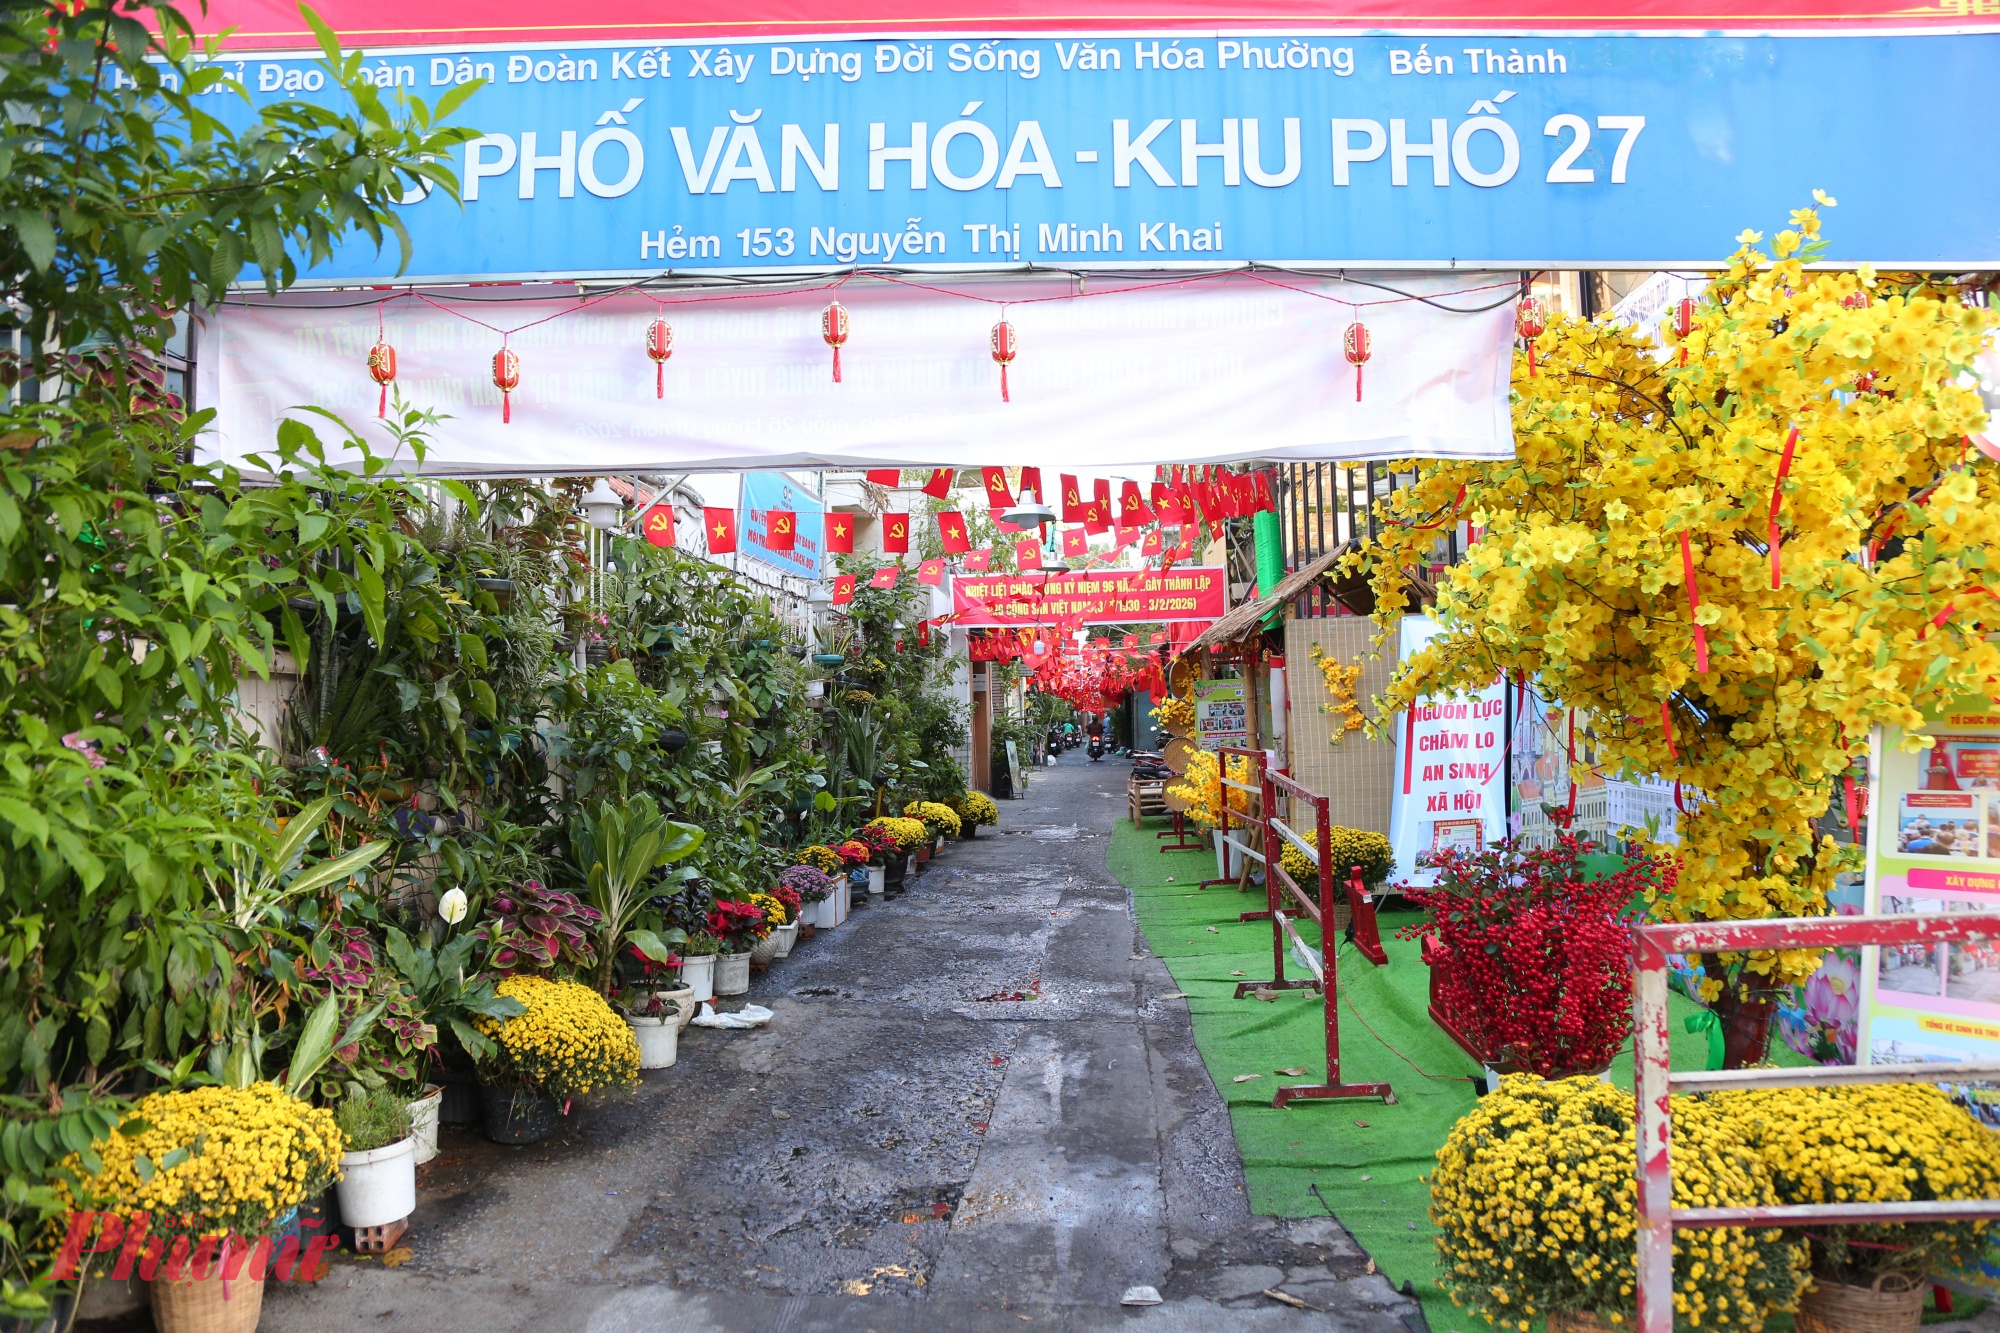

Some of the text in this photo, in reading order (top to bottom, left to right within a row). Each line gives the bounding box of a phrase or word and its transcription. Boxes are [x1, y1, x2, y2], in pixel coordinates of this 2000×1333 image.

[258, 62, 325, 98] Đạo
[339, 59, 415, 90] oàn
[430, 56, 495, 86] Dân
[507, 52, 597, 83] Đoàn
[611, 45, 671, 79] Kết
[688, 47, 755, 84] Xây
[769, 46, 862, 83] Dựng
[874, 42, 934, 73] Đời
[947, 39, 1041, 79] Sống
[1054, 40, 1121, 72] Văn
[1134, 38, 1204, 71] Hóa
[1217, 40, 1355, 77] Phường
[1389, 43, 1454, 75] Bến
[1463, 48, 1567, 75] Thành
[462, 97, 645, 202] PHỐ
[669, 108, 840, 194] VĂN
[868, 100, 1063, 191] HÓA
[1112, 117, 1302, 188] KHU
[1331, 89, 1521, 188] PHỐ
[1543, 113, 1646, 184] 27
[640, 217, 1223, 264] Hẻm 153 Nguyễn Thị Minh Khai
[965, 582, 988, 600] NHIỆT
[991, 582, 1007, 600] LIỆT
[1010, 580, 1033, 596] CHÀO
[1064, 578, 1075, 595] KỶ
[1077, 580, 1100, 596] NIỆM
[1102, 580, 1115, 593] 96
[1164, 574, 1192, 591] THÀNH
[1194, 574, 1211, 592] LẬP
[1006, 600, 1029, 618] CỘNG
[1050, 599, 1069, 617] VIỆT
[1148, 596, 1197, 611] 3/2/2026)
[1473, 699, 1503, 721] LỰC
[1419, 730, 1495, 752] CHĂM LO
[1422, 762, 1490, 782] AN SINH
[1426, 789, 1482, 813] XÃ HỘI
[1945, 874, 1966, 887] XÂY
[1967, 876, 1996, 891] DỰNG
